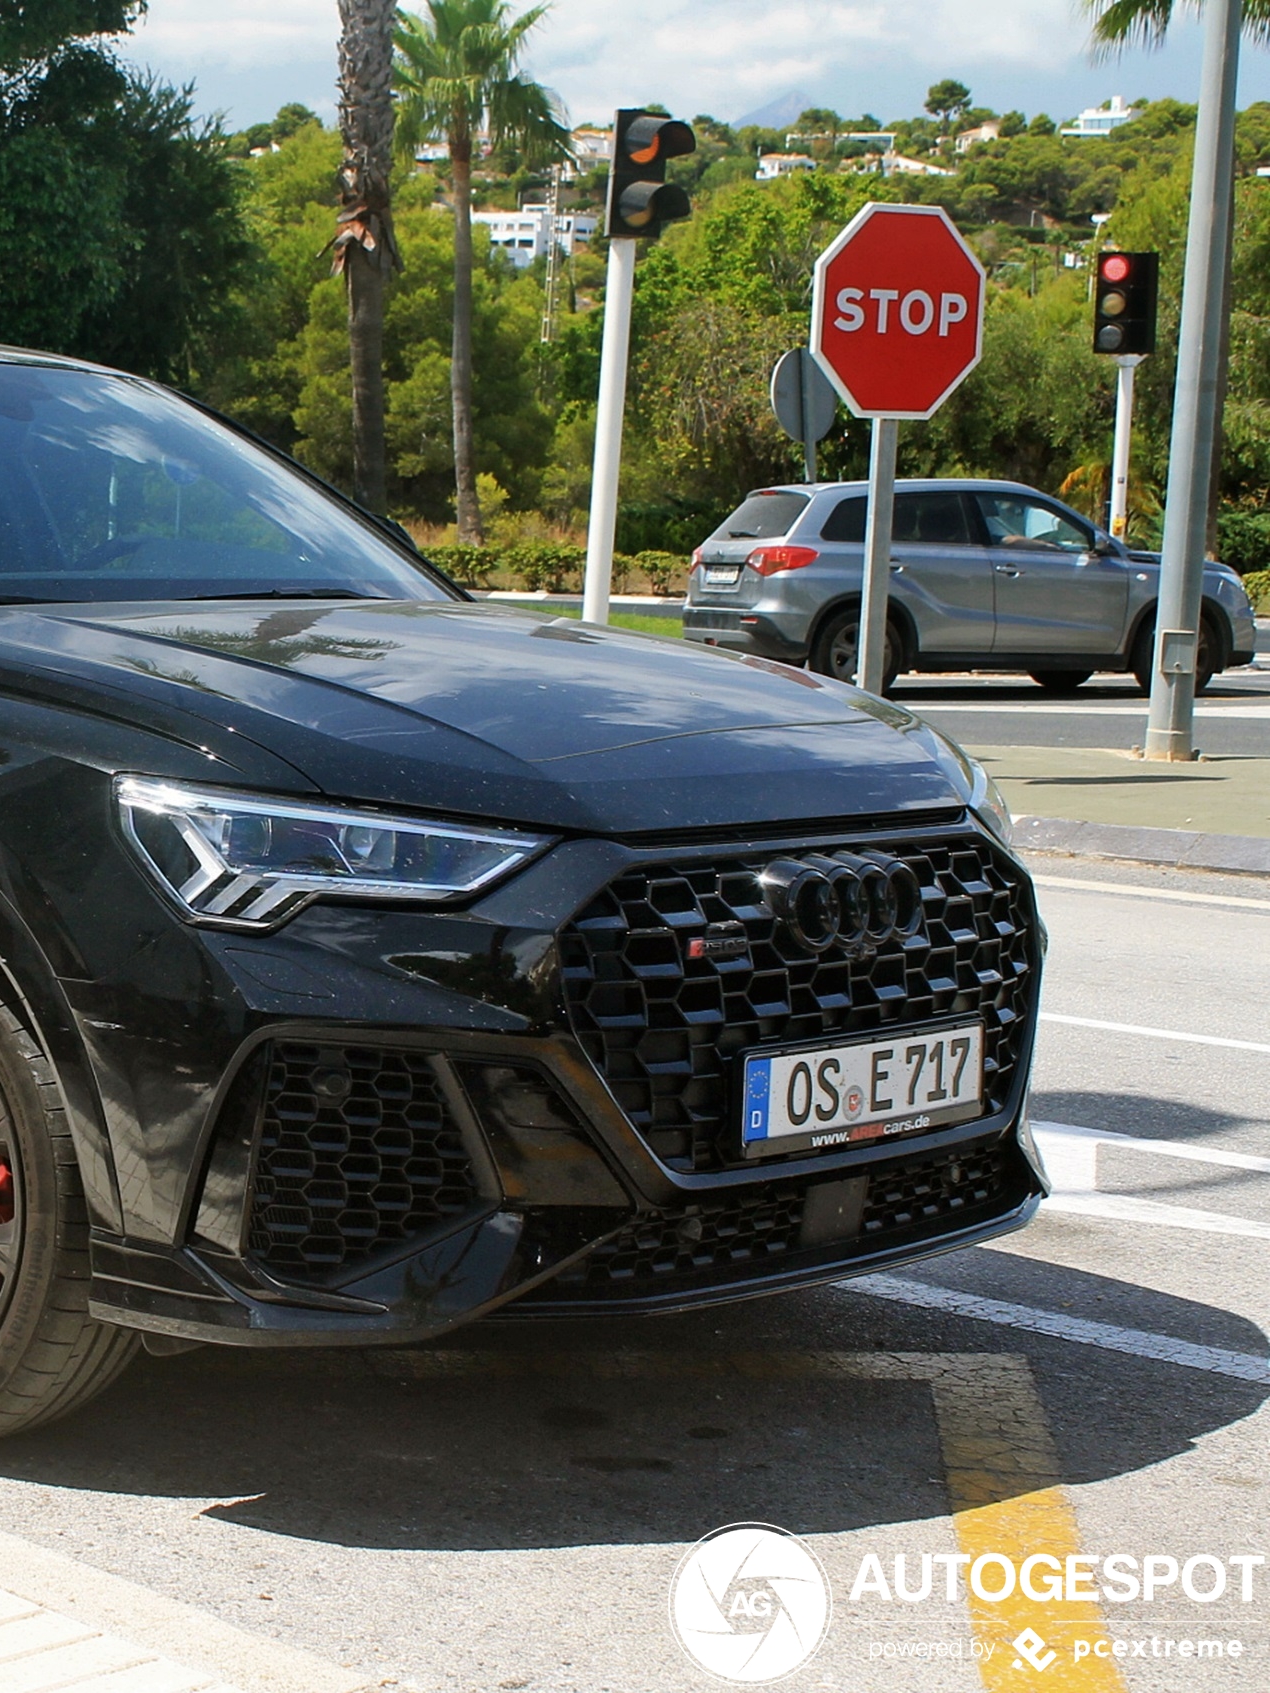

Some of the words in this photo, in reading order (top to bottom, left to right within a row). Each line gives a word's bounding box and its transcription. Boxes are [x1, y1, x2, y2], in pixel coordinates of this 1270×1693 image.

[833, 287, 968, 337] STOP
[787, 1058, 841, 1126] OS
[870, 1049, 894, 1112] E
[905, 1036, 971, 1106] 717
[751, 1110, 762, 1129] D
